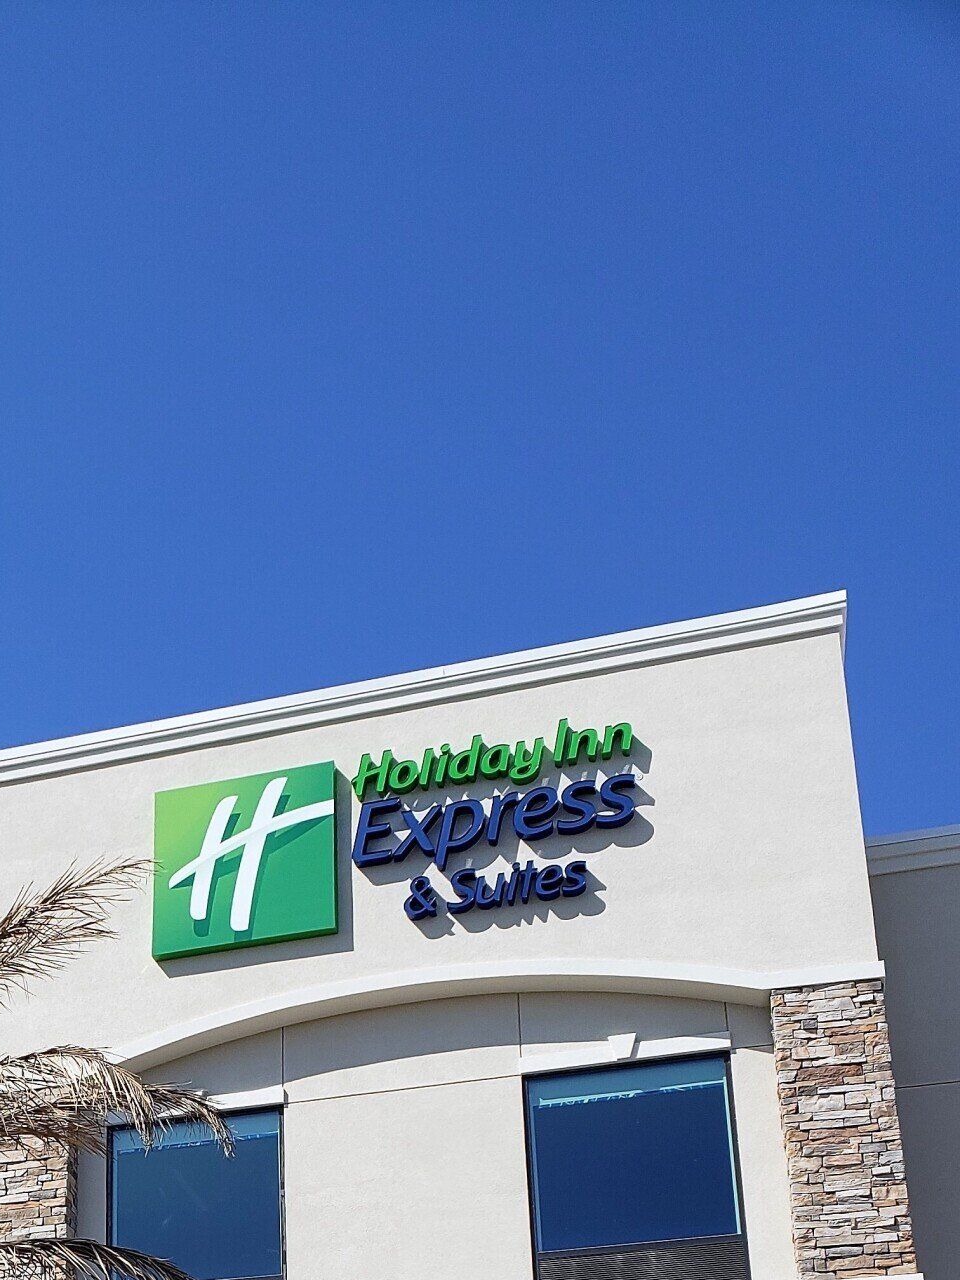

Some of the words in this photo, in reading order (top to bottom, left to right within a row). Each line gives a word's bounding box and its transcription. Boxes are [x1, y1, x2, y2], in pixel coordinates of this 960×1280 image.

[352, 734, 544, 801] Holiday
[553, 718, 634, 767] Inn
[352, 773, 637, 871] Express
[404, 876, 437, 920] &
[447, 860, 587, 914] Suites
